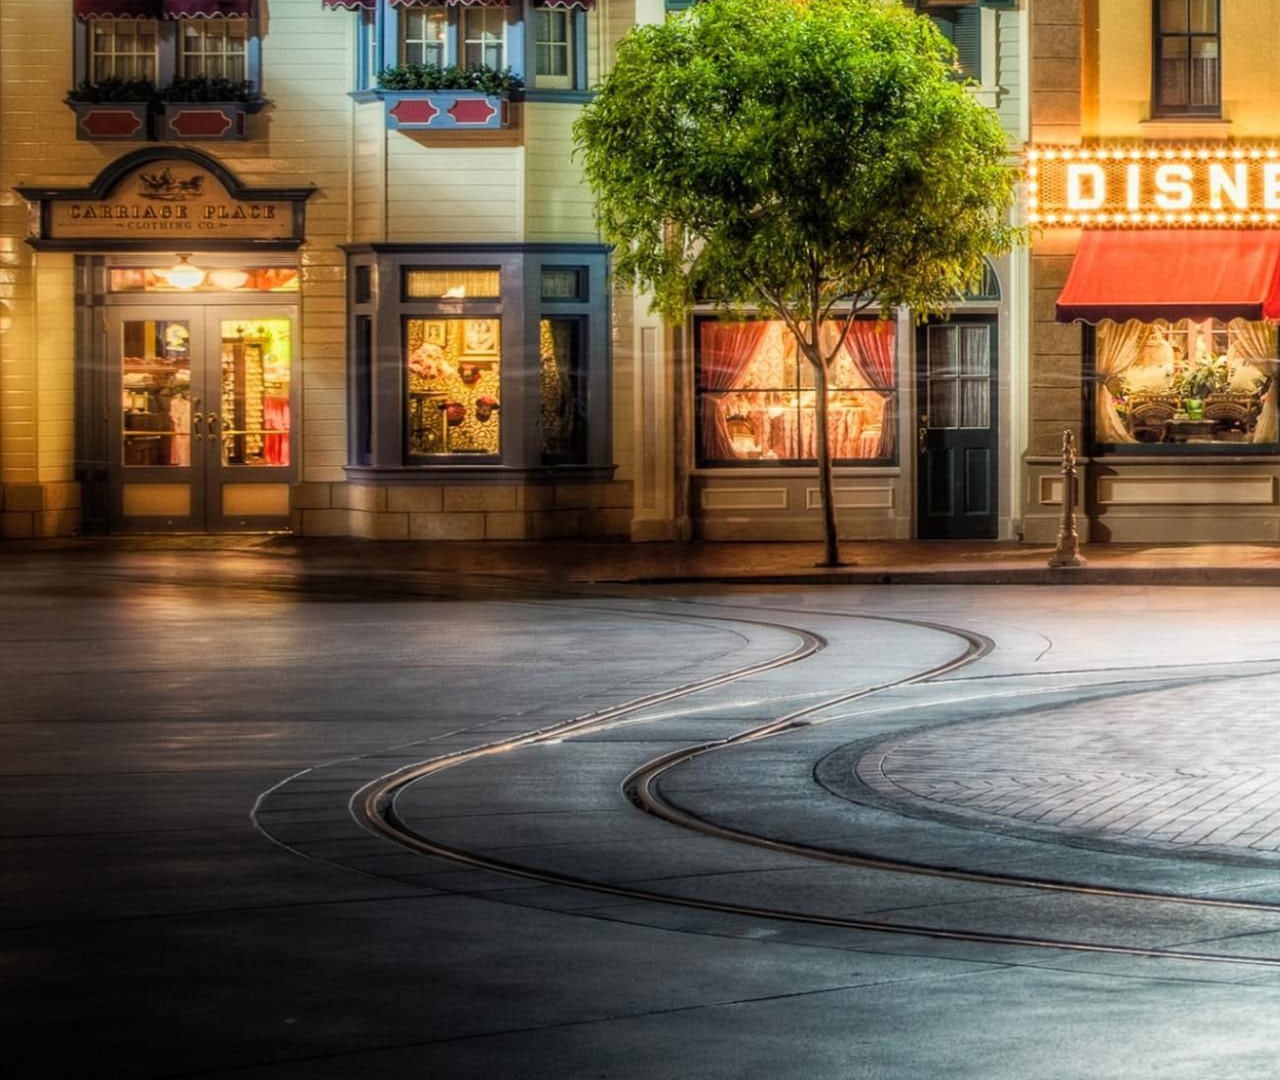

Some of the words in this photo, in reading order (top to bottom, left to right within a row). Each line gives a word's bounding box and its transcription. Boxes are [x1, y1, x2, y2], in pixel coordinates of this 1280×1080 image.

[70, 205, 189, 219] CARRIAGE
[204, 205, 275, 219] PLACE
[127, 221, 192, 230] CLOTHING
